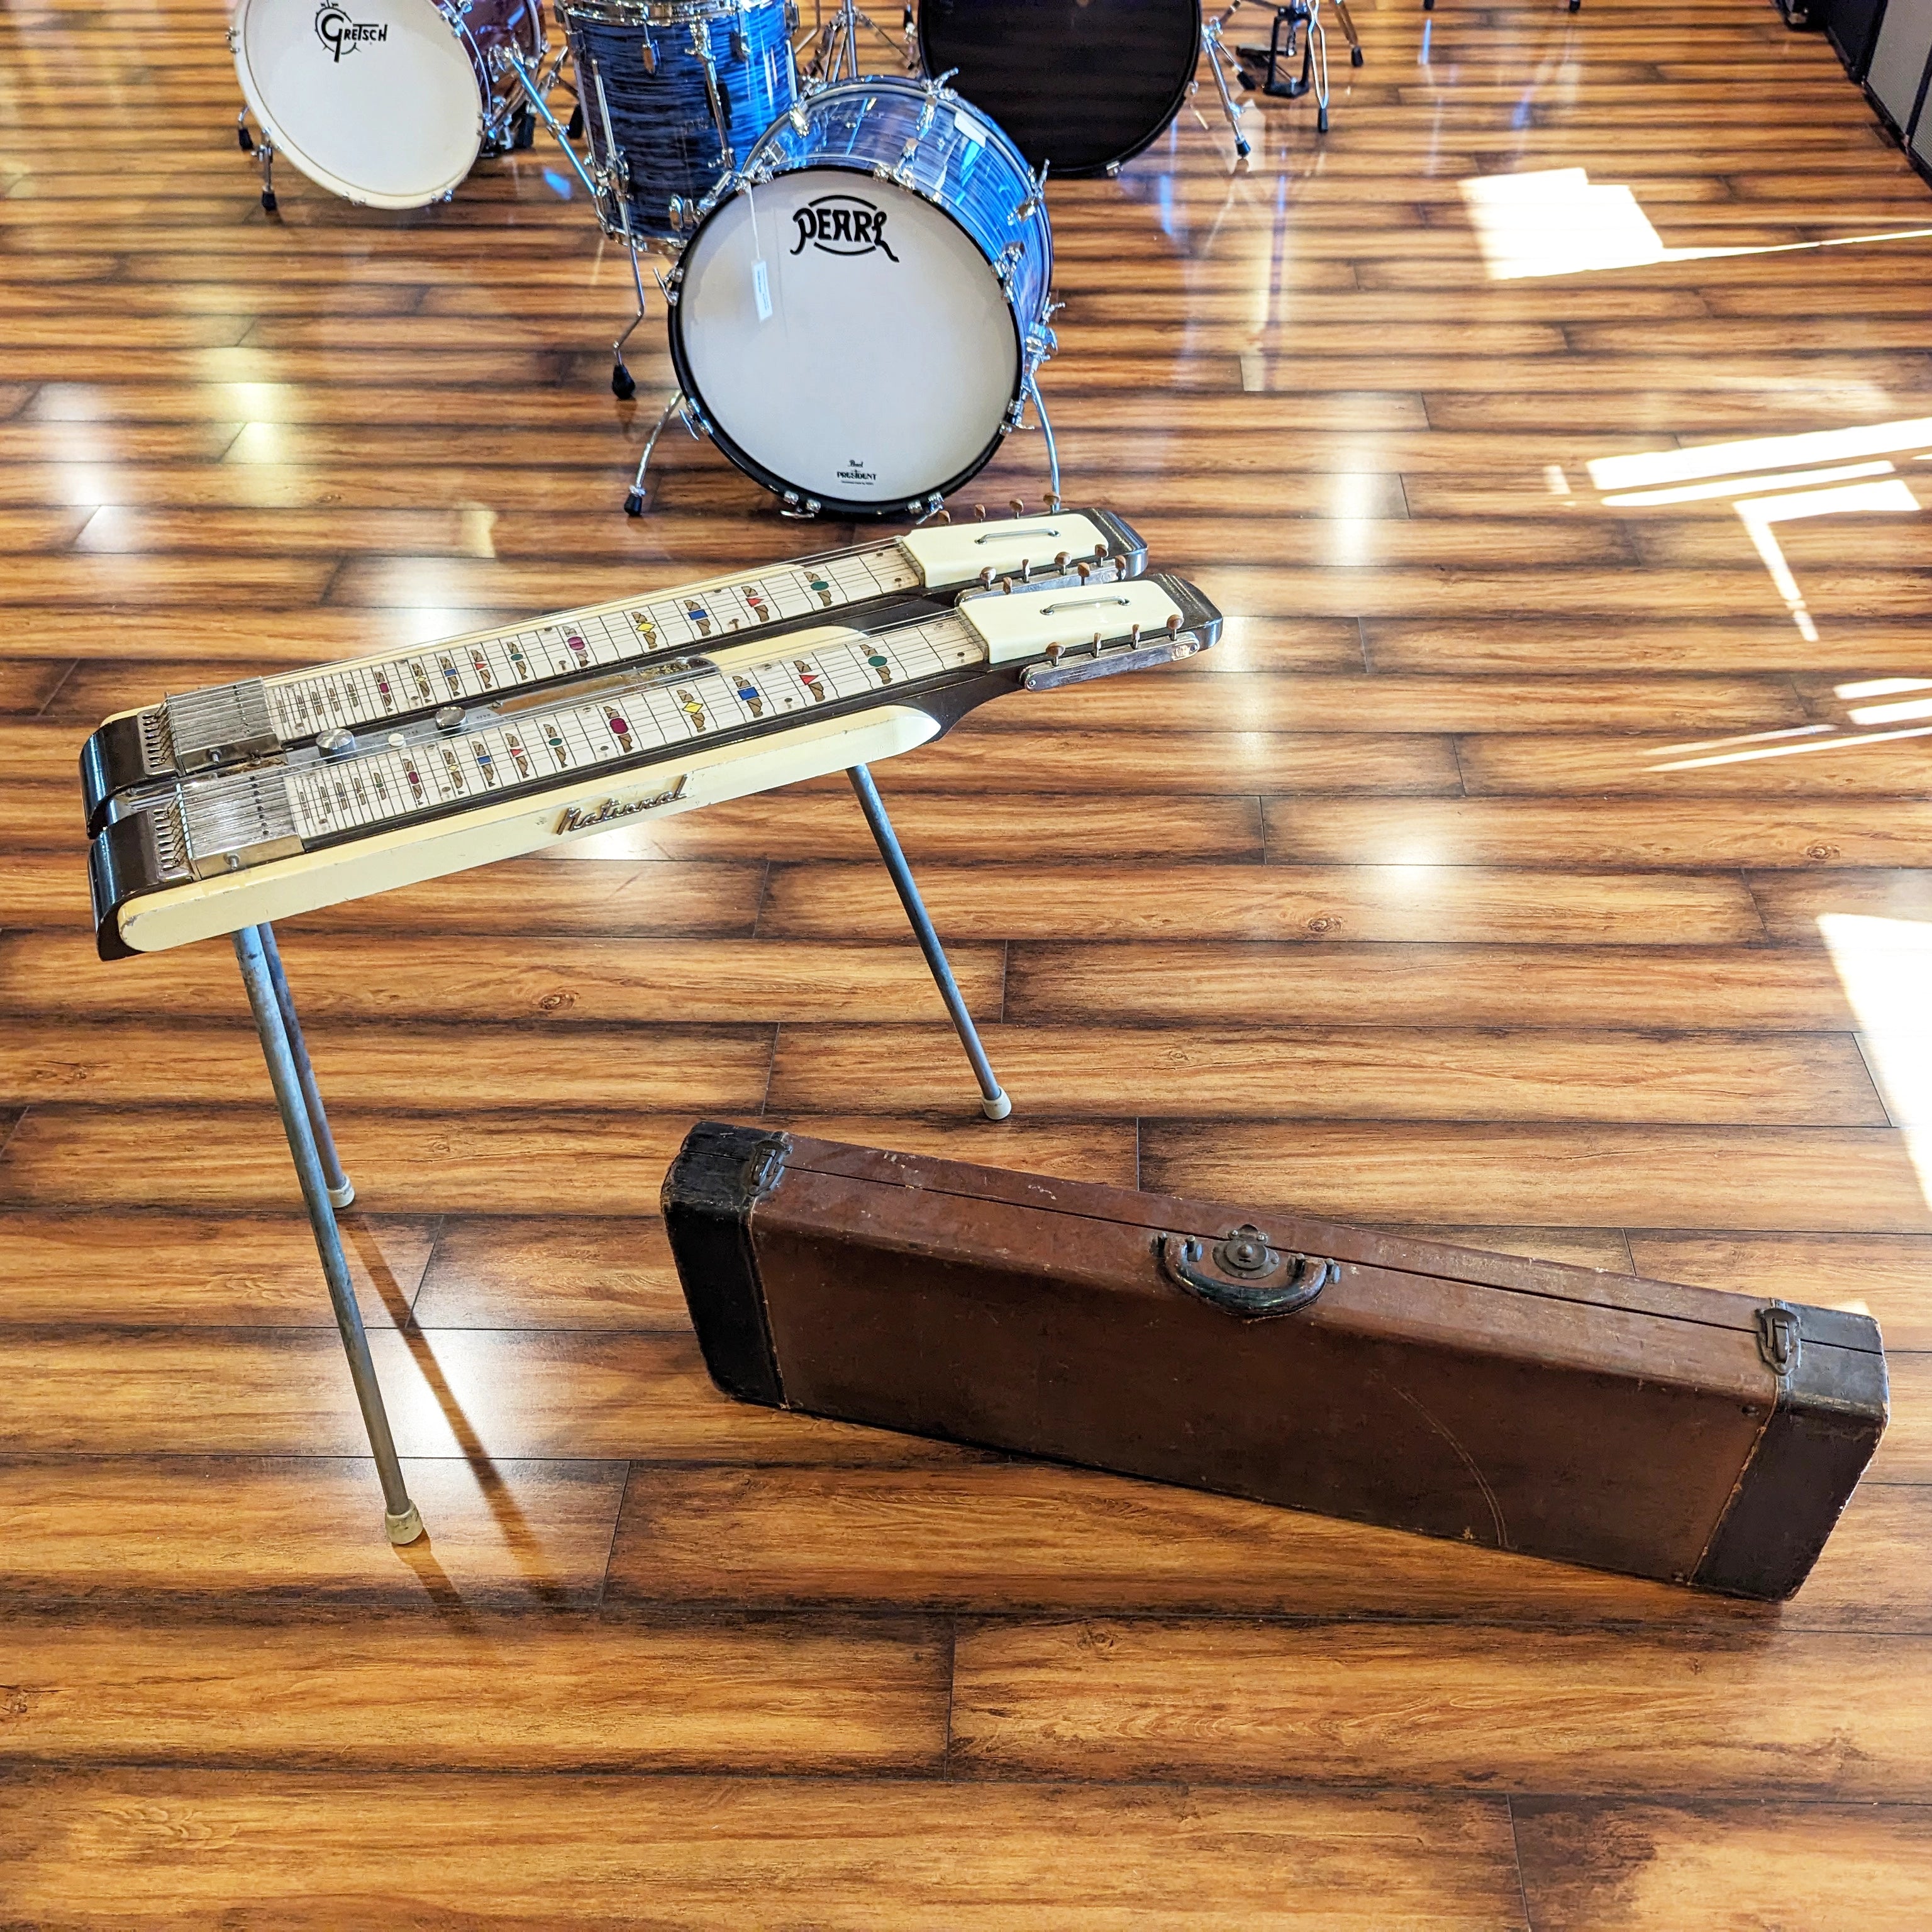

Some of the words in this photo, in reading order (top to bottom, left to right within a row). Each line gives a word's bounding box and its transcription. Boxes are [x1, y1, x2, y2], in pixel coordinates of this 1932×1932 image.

[321, 13, 388, 64] GRETSCH
[836, 470, 877, 480] PRESIDENT
[556, 774, 688, 836] National
